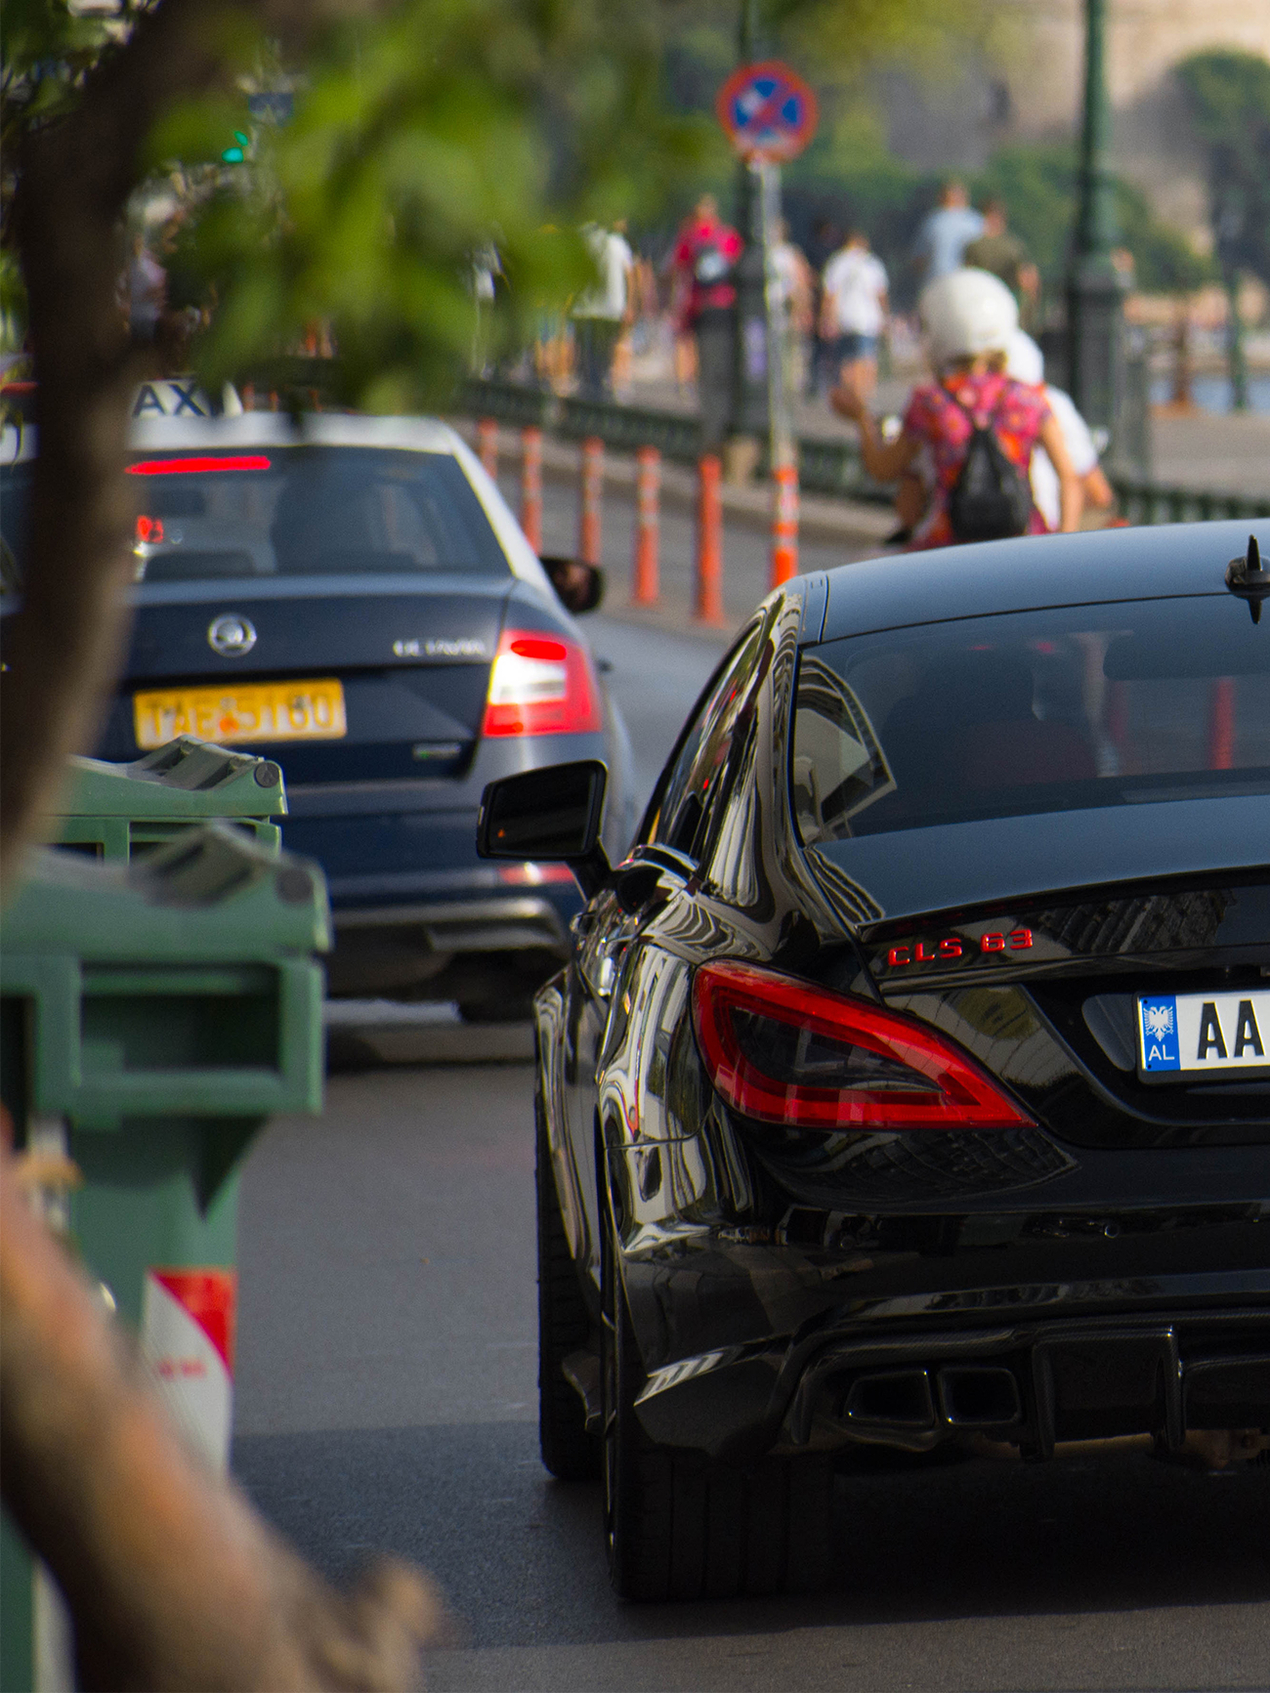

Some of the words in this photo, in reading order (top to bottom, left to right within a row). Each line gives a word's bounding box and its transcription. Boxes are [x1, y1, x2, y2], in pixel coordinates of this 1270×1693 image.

[887, 937, 963, 967] CLS
[980, 928, 1034, 954] 63
[1196, 998, 1266, 1060] AA
[1148, 1044, 1175, 1061] AL
